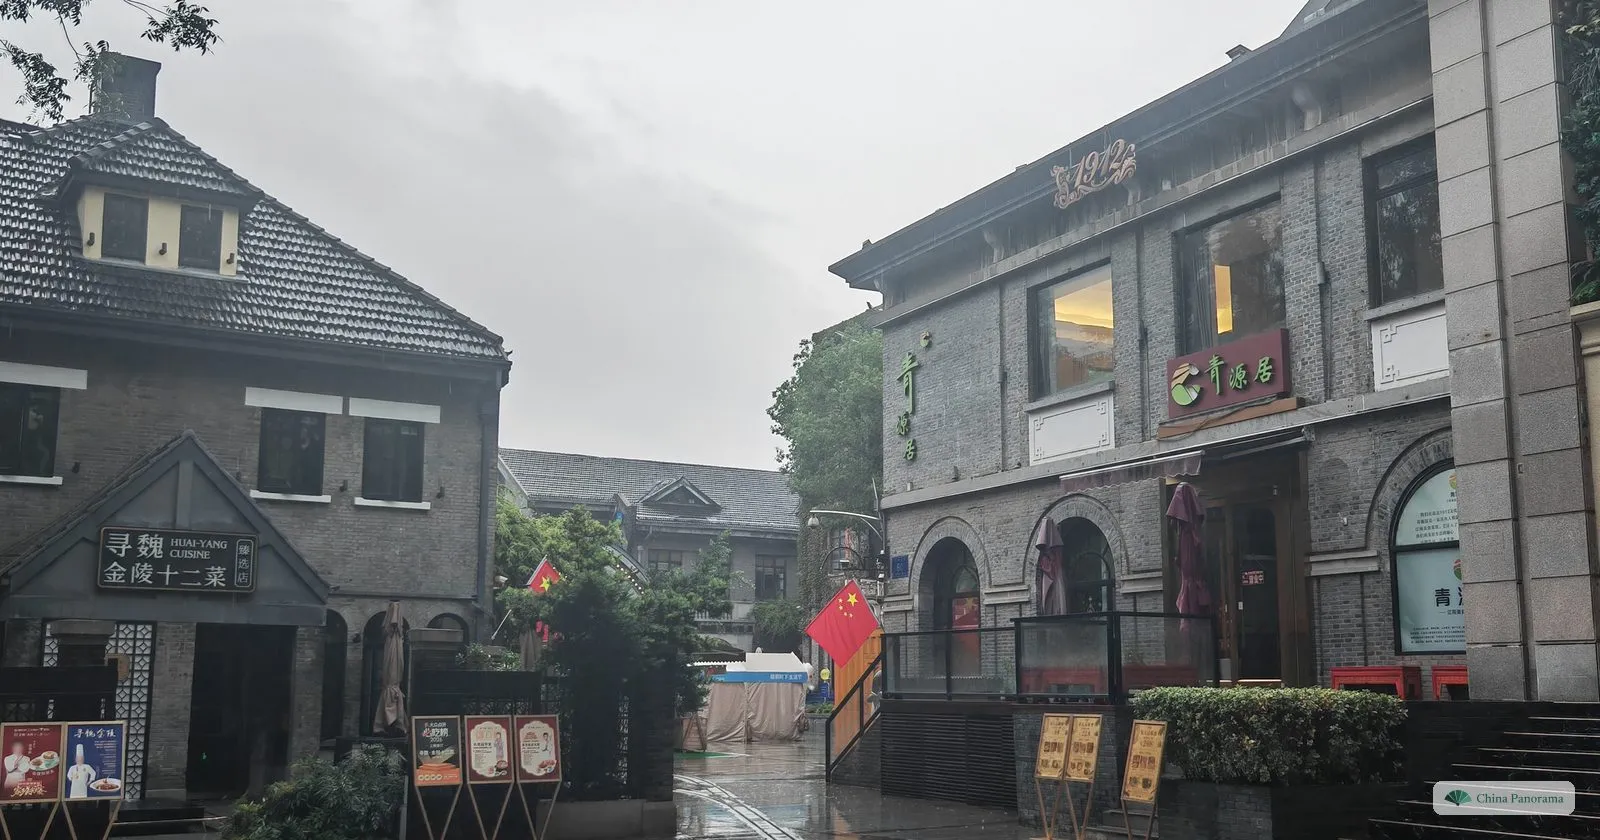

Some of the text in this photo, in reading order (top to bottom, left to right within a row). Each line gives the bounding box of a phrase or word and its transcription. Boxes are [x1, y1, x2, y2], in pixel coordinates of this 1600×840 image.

[1072, 139, 1135, 188] 1912
[1203, 354, 1273, 395] 青源居
[897, 351, 919, 461] 青源居
[105, 533, 164, 559] 寻魏
[170, 538, 228, 550] HUAI-YANG
[170, 549, 211, 560] CUISINE
[104, 561, 227, 588] 金陵十二菜
[238, 544, 249, 583] 臻选店
